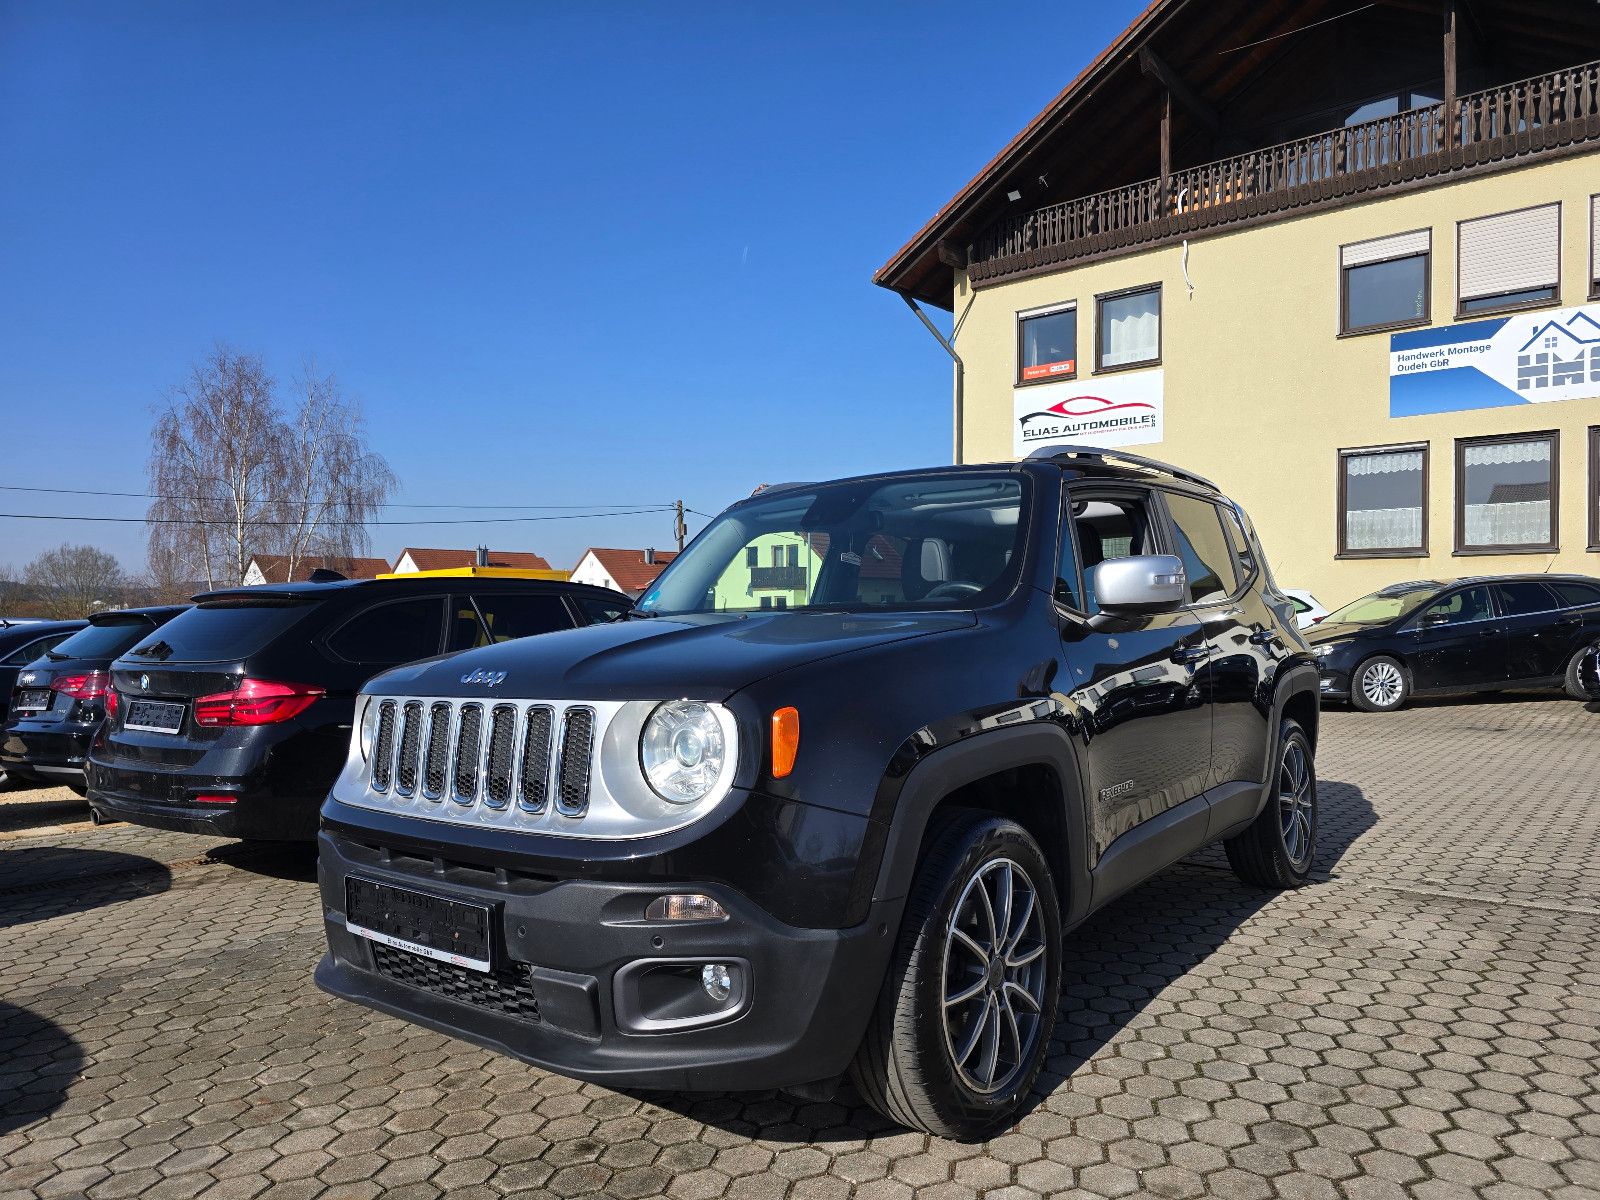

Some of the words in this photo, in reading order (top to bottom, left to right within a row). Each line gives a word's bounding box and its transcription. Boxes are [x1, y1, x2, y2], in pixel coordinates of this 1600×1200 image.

[1397, 349, 1446, 362] Handwerk
[1447, 344, 1492, 355] Montage
[1397, 361, 1428, 372] Oudeh
[1430, 359, 1450, 368] GbR
[1023, 426, 1059, 437] ELIAS
[1063, 415, 1150, 432] AUTOMOBILE
[460, 668, 508, 688] Jeep
